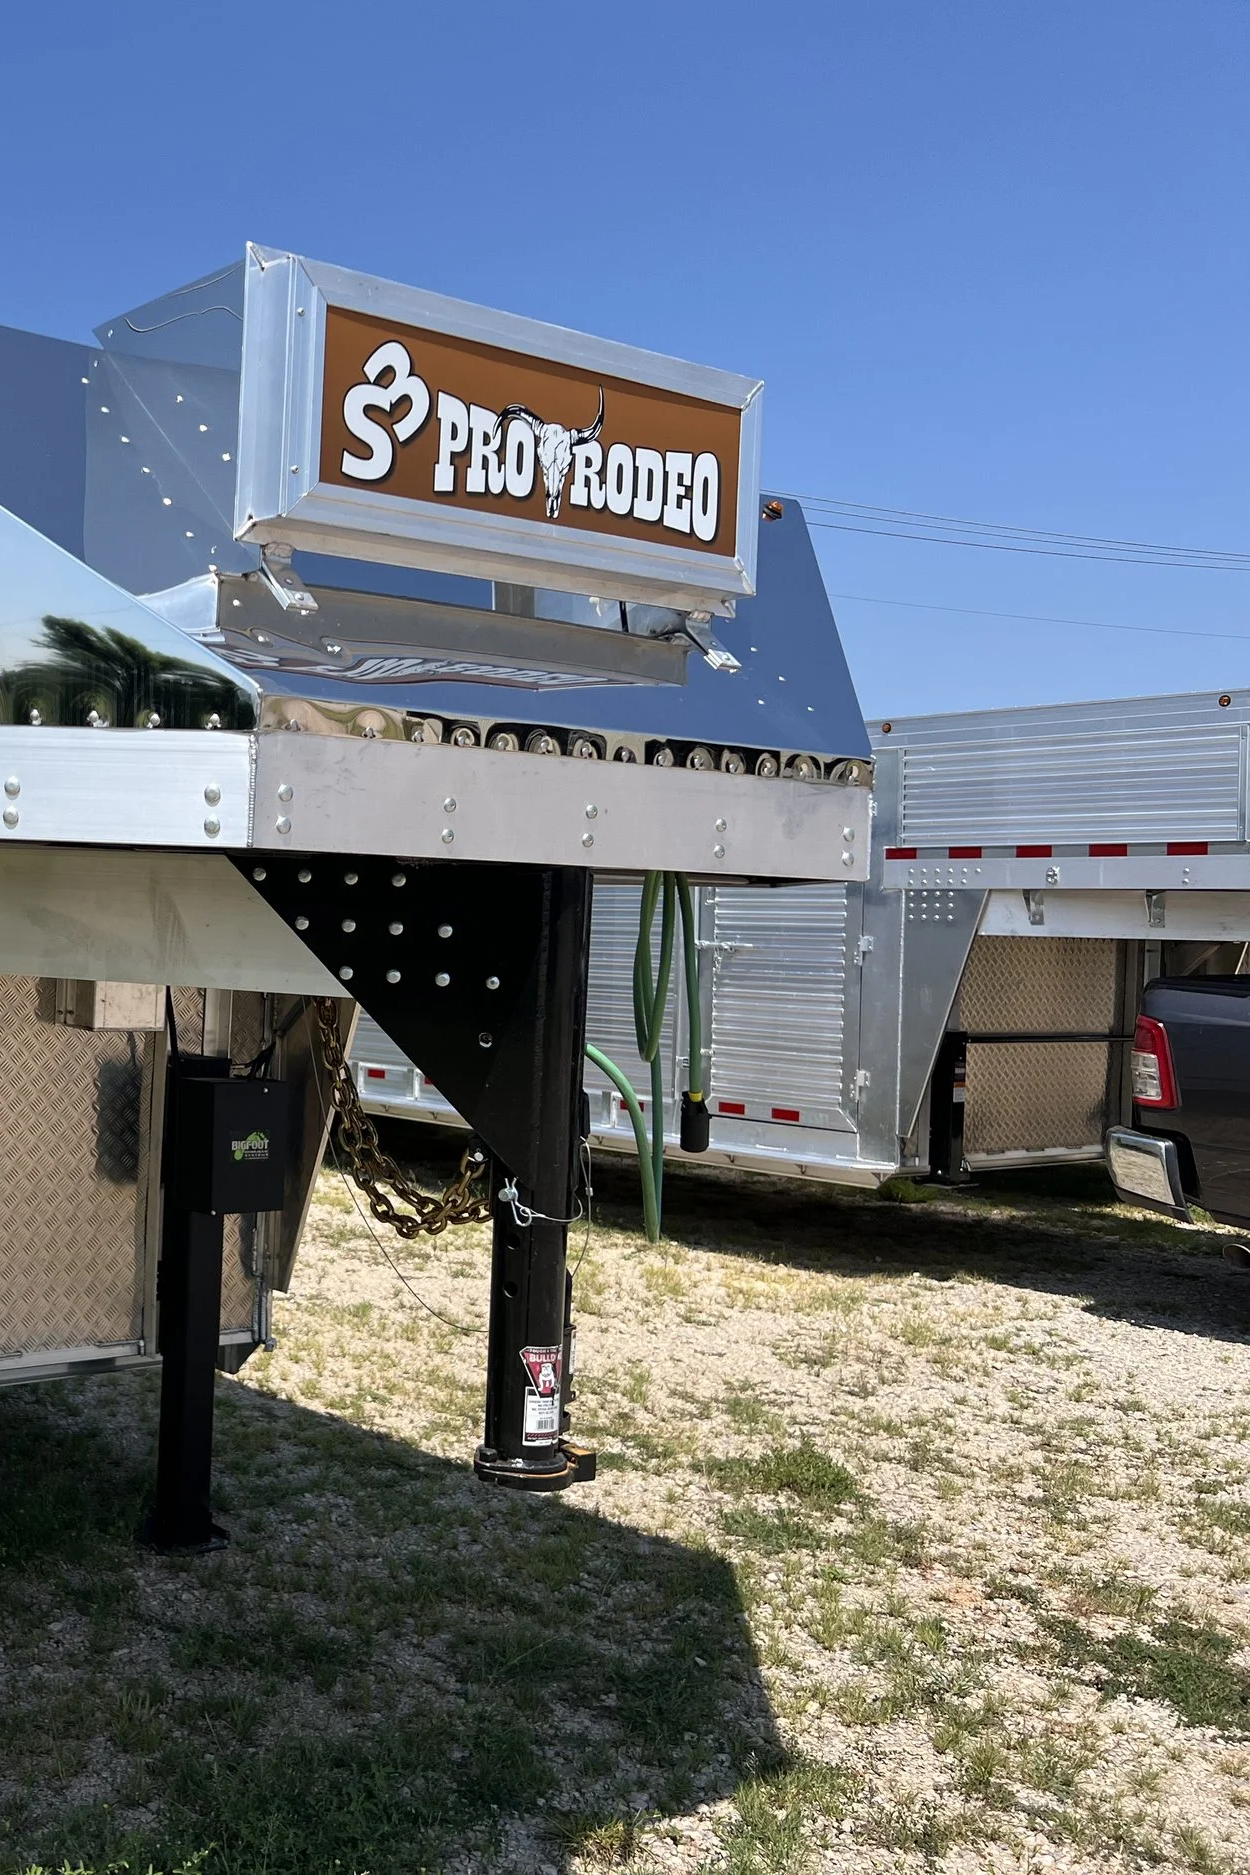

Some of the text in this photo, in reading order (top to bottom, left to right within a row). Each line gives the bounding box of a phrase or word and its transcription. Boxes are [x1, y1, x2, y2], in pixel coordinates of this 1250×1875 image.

[433, 390, 536, 498] PRO
[570, 440, 720, 542] RODEO
[232, 1140, 269, 1150] BIGFOOT
